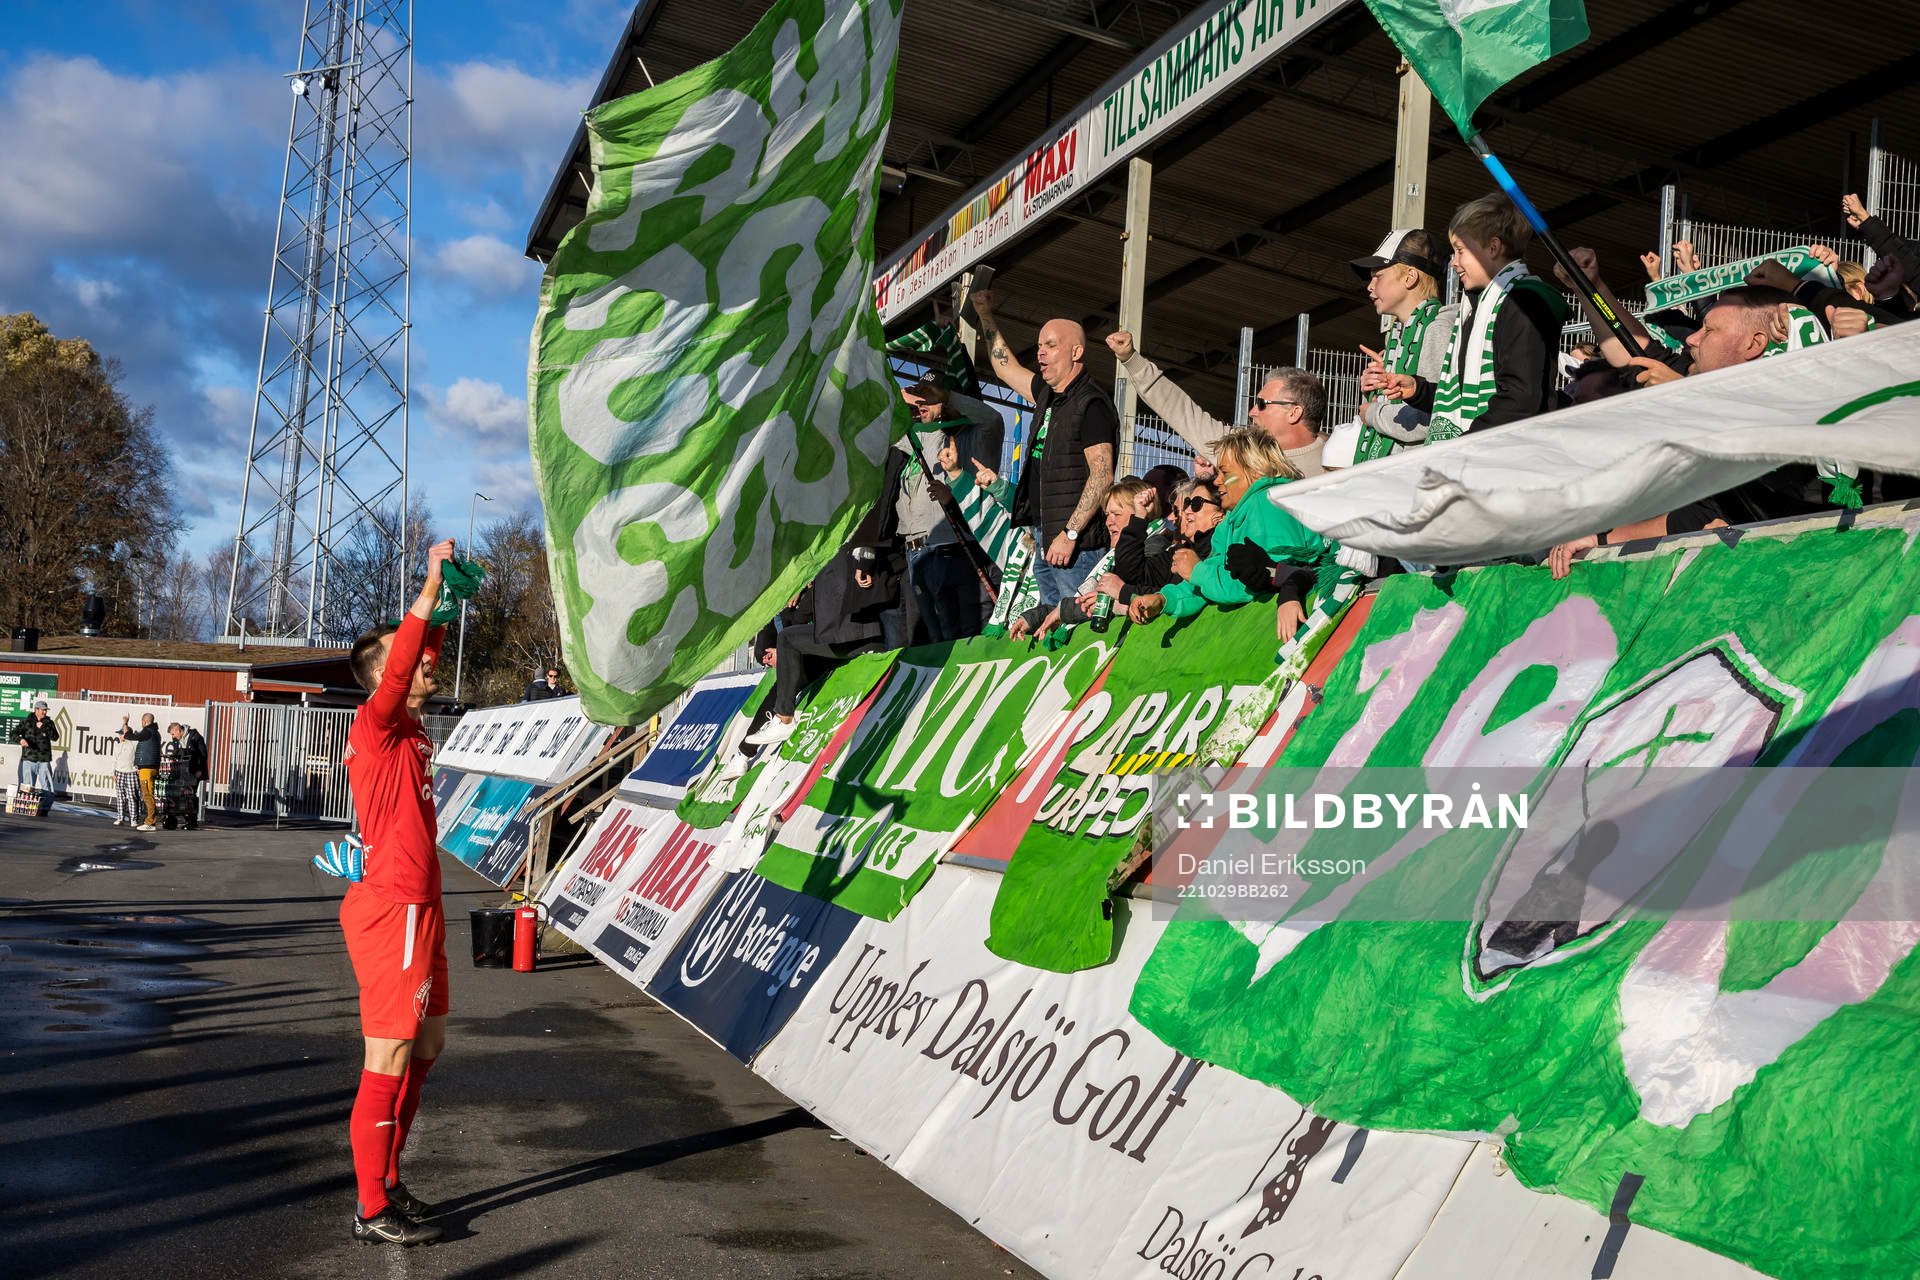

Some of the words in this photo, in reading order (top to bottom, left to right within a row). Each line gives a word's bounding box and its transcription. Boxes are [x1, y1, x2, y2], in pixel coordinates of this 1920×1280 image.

[1103, 0, 1248, 157] TILLSAMMANS
[1024, 129, 1077, 203] MAXI
[1032, 173, 1074, 214] STORMARKNAD
[909, 249, 957, 296] Destination
[973, 210, 1009, 249] Dalarna
[1658, 277, 1693, 302] VSK
[733, 907, 820, 997] Borlänge
[829, 944, 939, 1053] Upplev
[922, 978, 1075, 1120] Dalsjö
[1053, 1027, 1214, 1163] Golf
